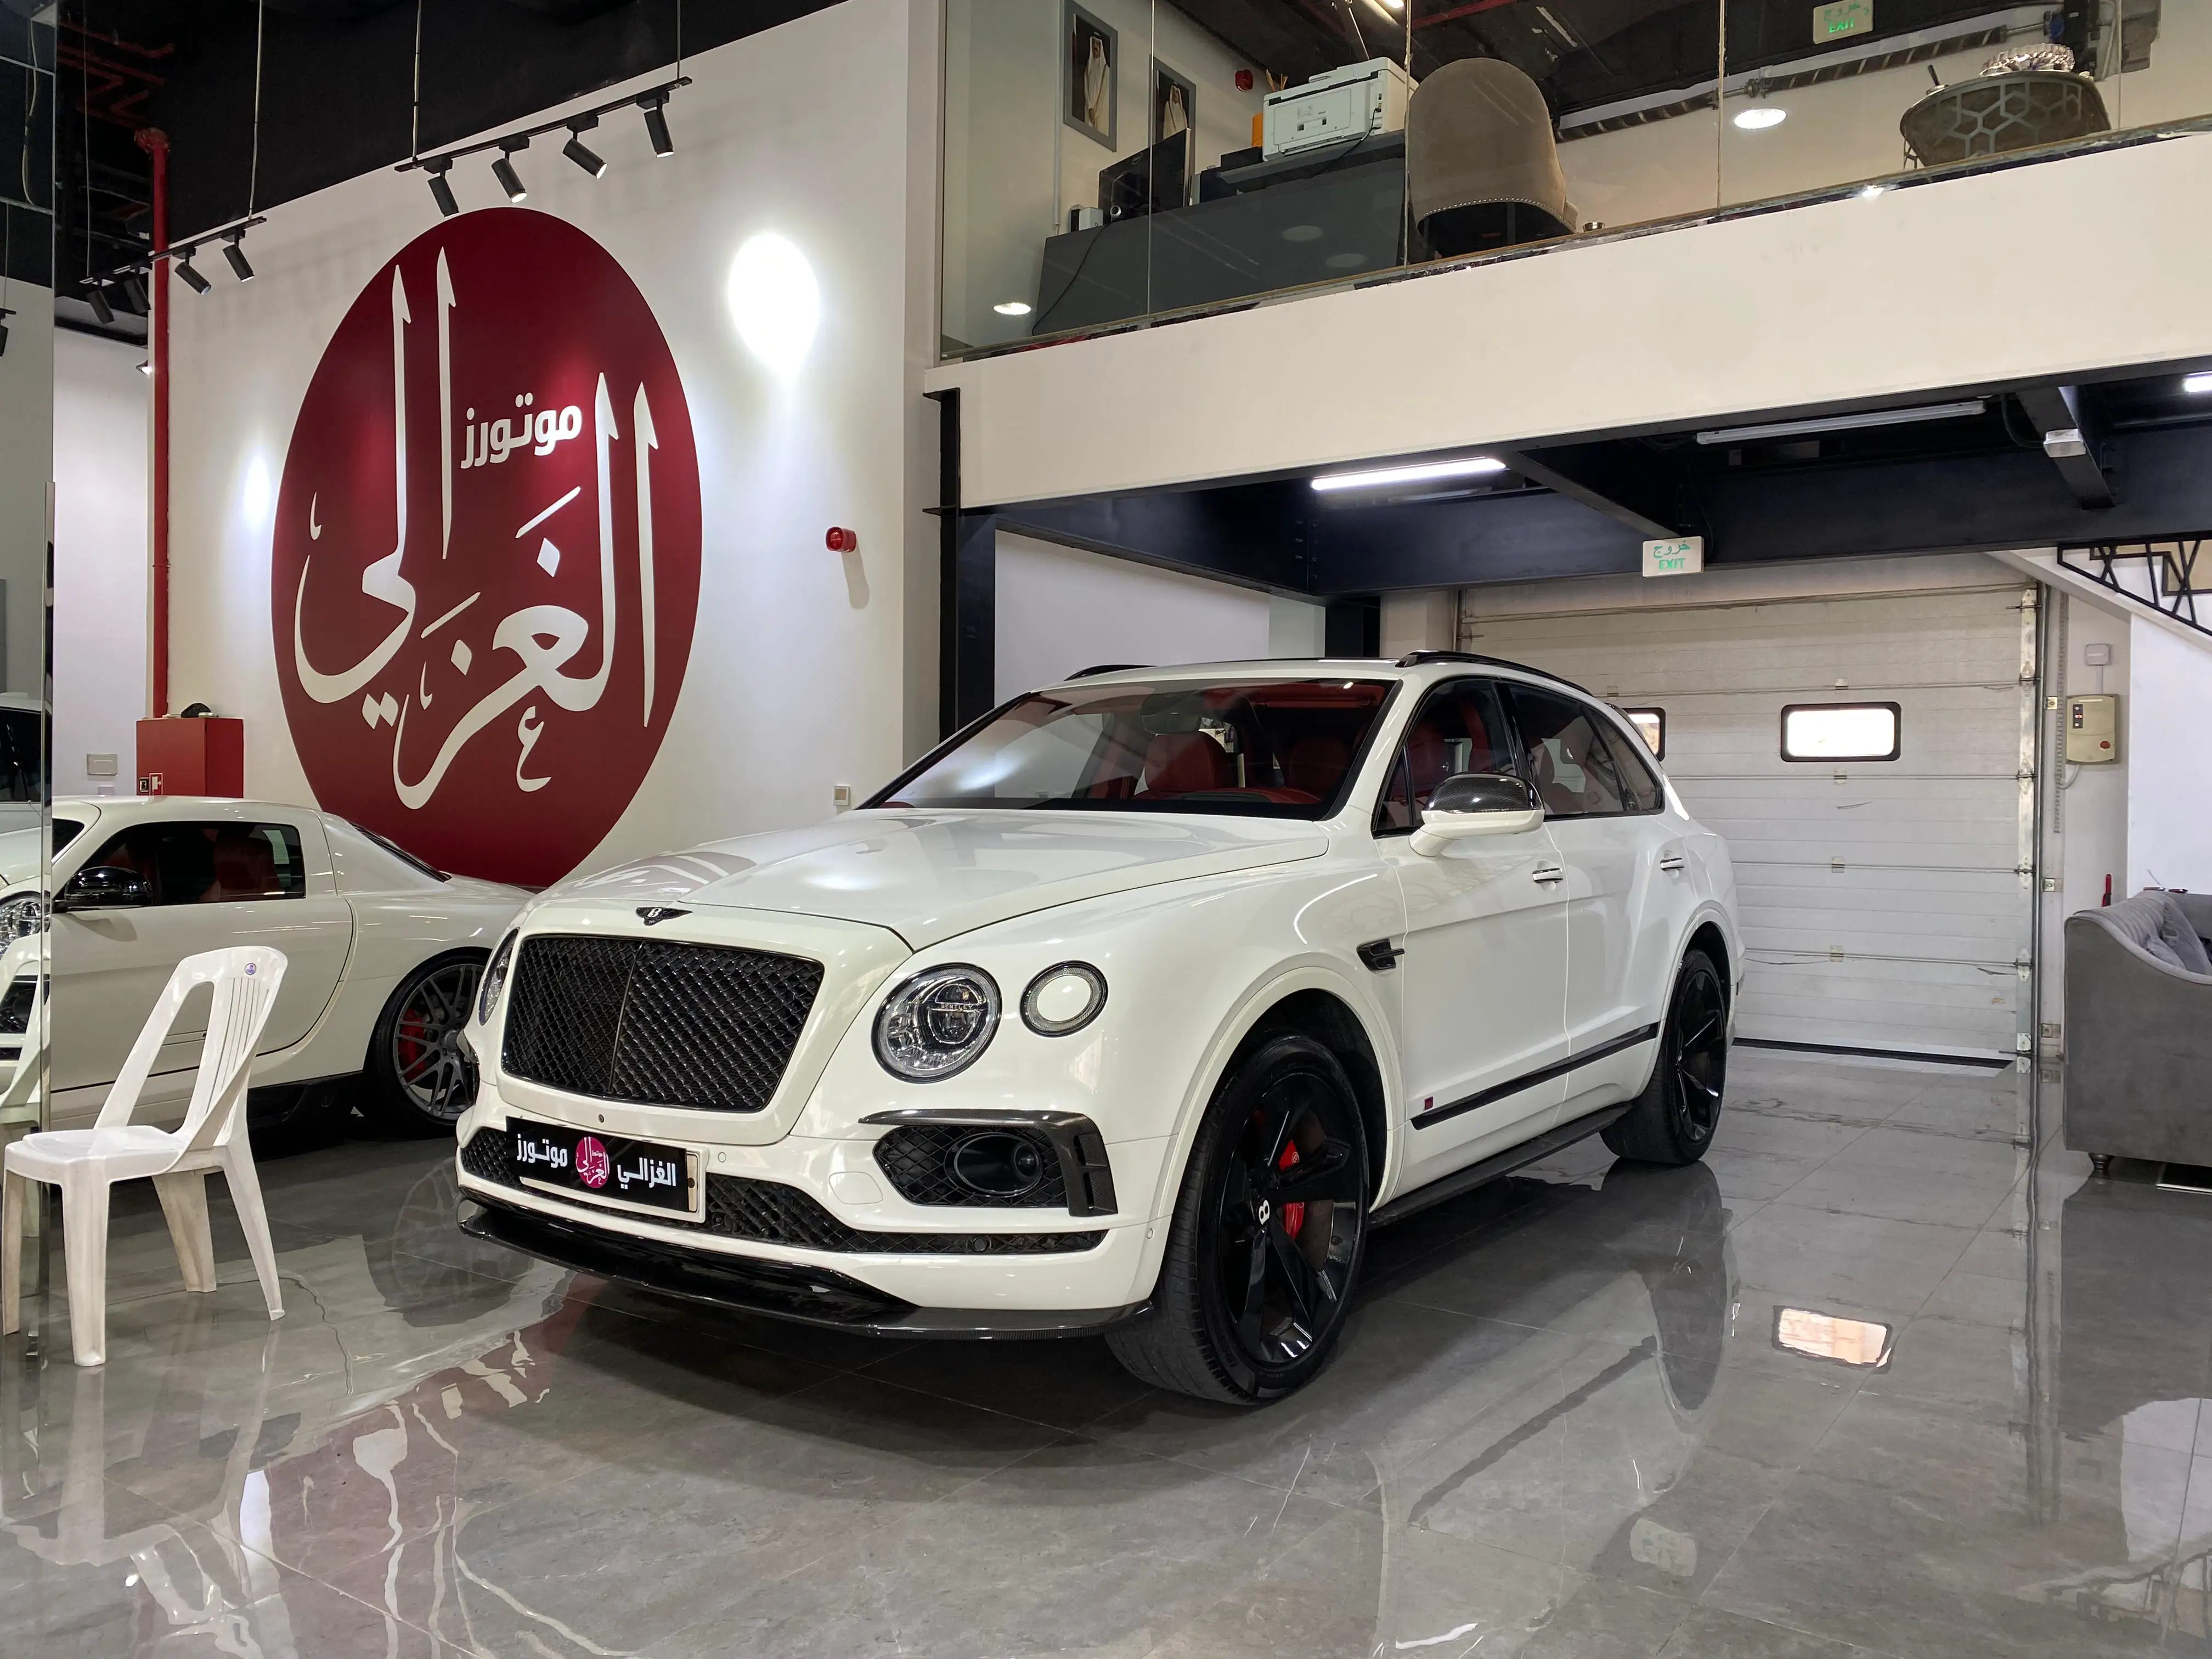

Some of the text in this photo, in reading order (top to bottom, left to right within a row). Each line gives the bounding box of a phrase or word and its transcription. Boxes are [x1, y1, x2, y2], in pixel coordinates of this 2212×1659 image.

[460, 392, 582, 469] موتورز
[1653, 540, 1691, 559] خروج
[1659, 557, 1686, 571] EXIT
[517, 1134, 676, 1190] الغزالي موتورز
